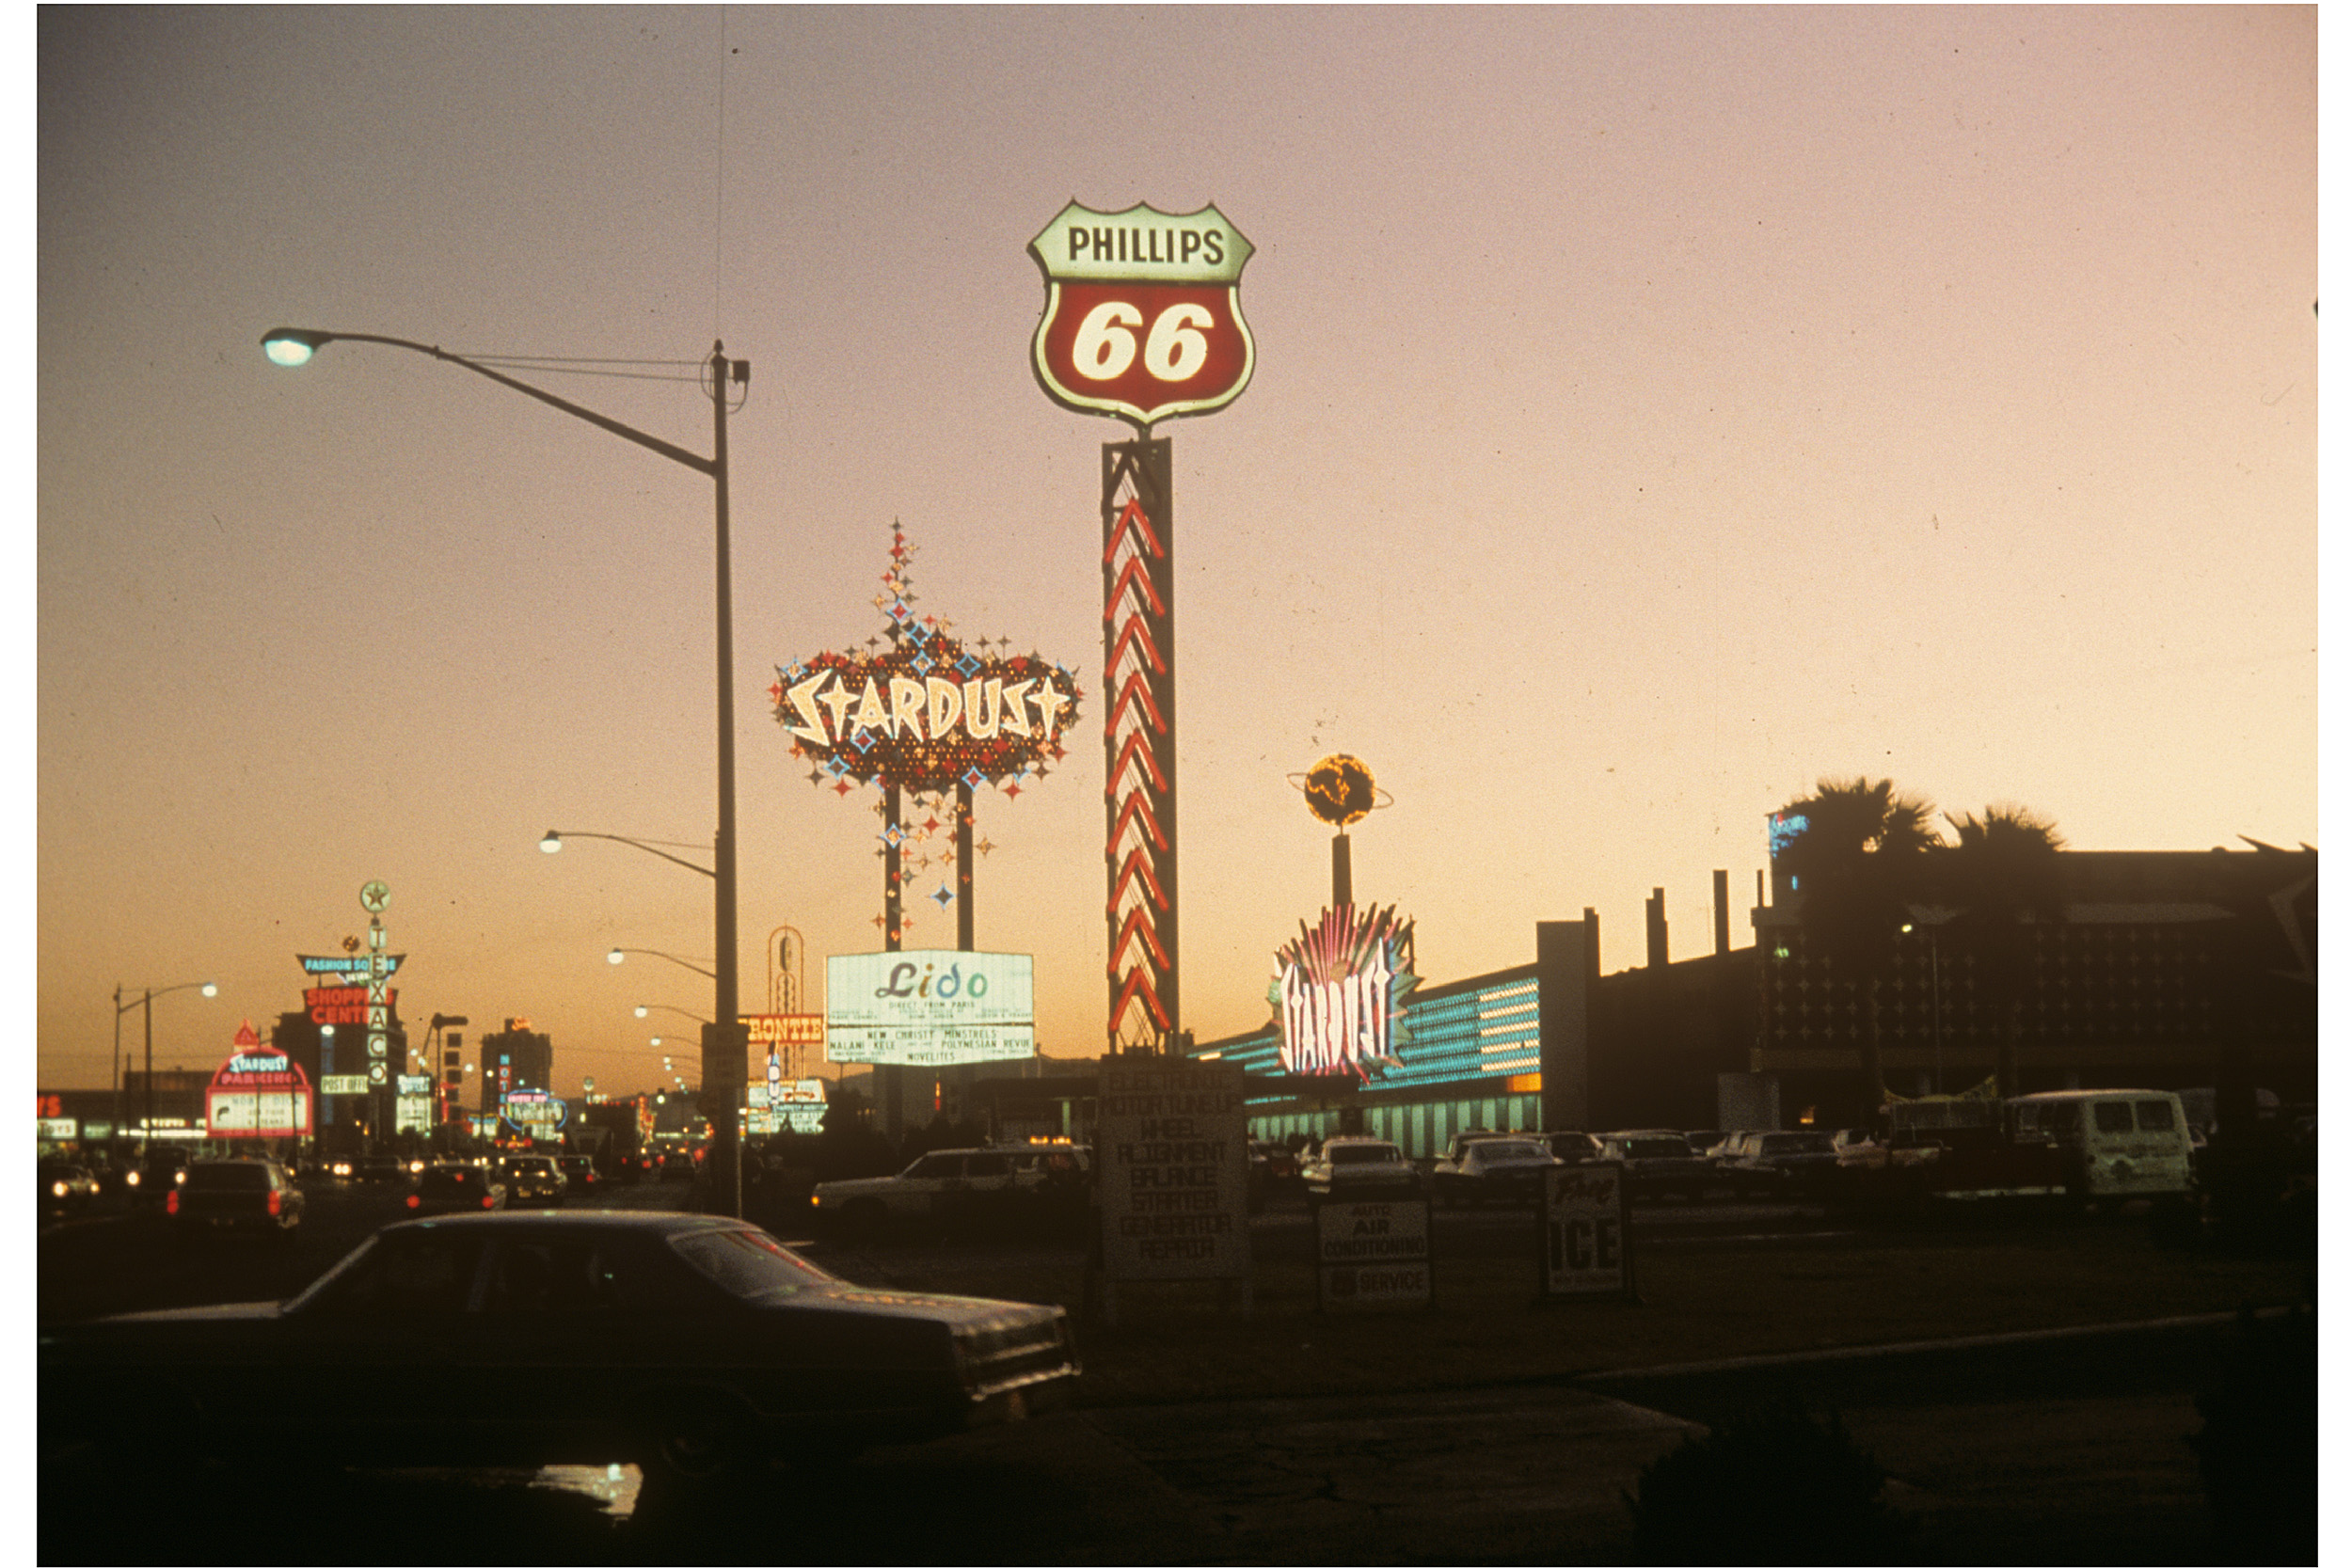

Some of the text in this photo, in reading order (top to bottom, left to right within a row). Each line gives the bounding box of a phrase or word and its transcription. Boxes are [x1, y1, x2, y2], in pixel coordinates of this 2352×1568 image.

[1068, 226, 1224, 266] PHILLIPS
[1072, 300, 1215, 382] 66
[783, 668, 1071, 747] STARDUST
[305, 958, 396, 971] FASHION SQE
[875, 962, 989, 999] Lido
[307, 988, 394, 1006] SHOPPIG
[370, 927, 385, 1082] TEXACO
[889, 1001, 917, 1009] DIRECT
[1279, 936, 1391, 1073] STARDUST
[829, 1040, 865, 1050] NALANI
[873, 1040, 896, 1050] KELE
[942, 1039, 997, 1049] POLYNESIAN
[1003, 1038, 1030, 1048] REVUE
[867, 1029, 997, 1040] NEW CHRISTY MINSTRELS
[1140, 1117, 1202, 1139] WHEEL
[1117, 1141, 1228, 1164] ALIGNMENT
[1131, 1166, 1218, 1187] BALANCE
[1132, 1190, 1219, 1212] STARTER
[1351, 1205, 1391, 1216] AUTO
[1119, 1212, 1232, 1236] GENERATOR
[1352, 1219, 1391, 1235] AIR
[1139, 1236, 1215, 1259] REPAIR
[1325, 1236, 1426, 1257] CONDITIONING
[1549, 1216, 1617, 1271] ICE
[1359, 1266, 1424, 1291] SERVICE
